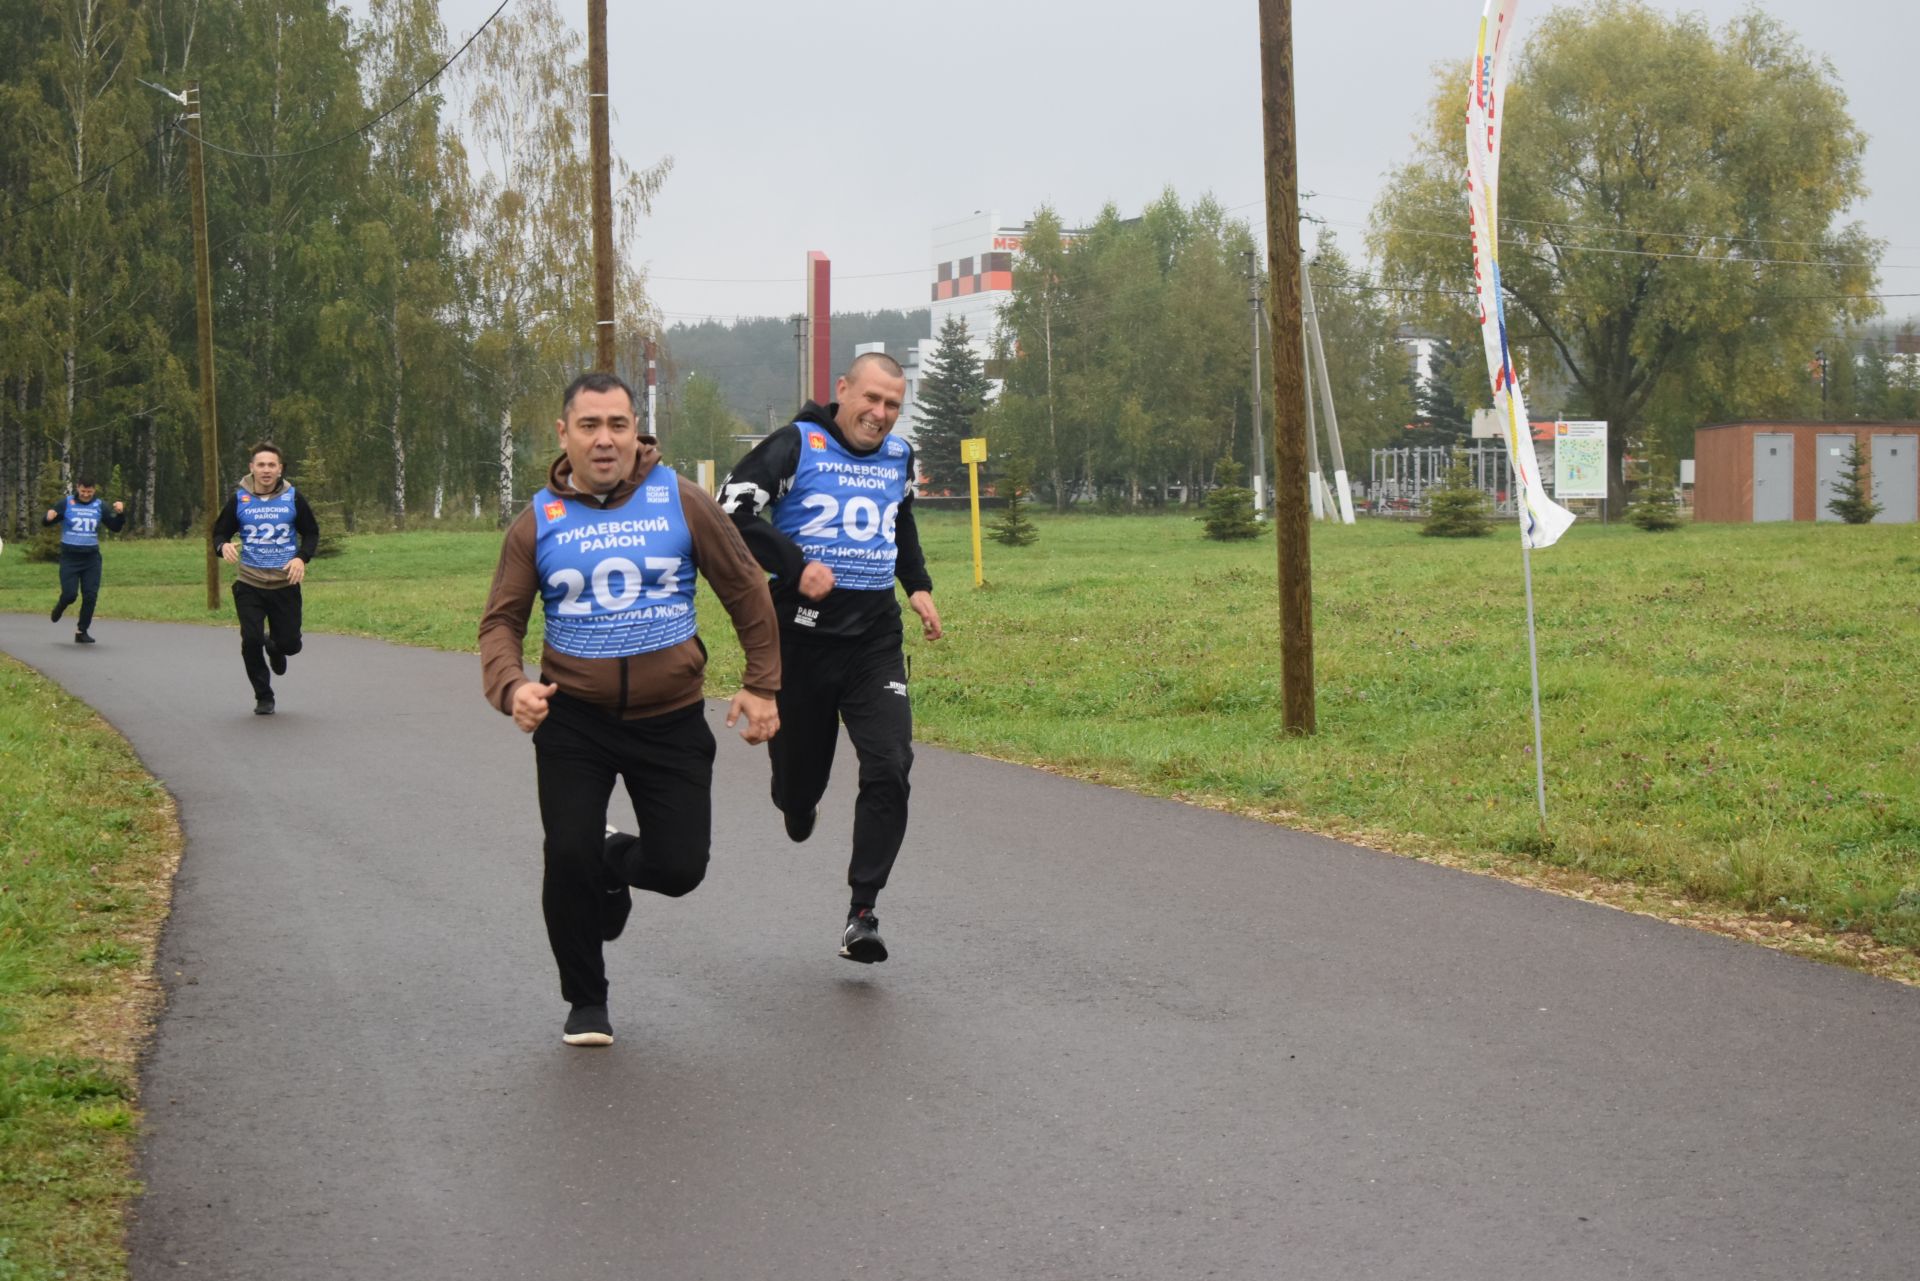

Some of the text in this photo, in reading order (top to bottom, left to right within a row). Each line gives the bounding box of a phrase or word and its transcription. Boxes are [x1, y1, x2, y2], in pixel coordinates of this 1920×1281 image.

[816, 462, 899, 480] ТУКАЕВСКИЙ
[838, 475, 886, 490] РАЙОН
[71, 517, 98, 532] 211
[254, 512, 279, 520] РАЙОН
[243, 523, 291, 544] 222
[555, 517, 670, 545] ТУКАЕВСКИЙ
[580, 534, 646, 553] РАЙОН
[547, 557, 682, 615] 203
